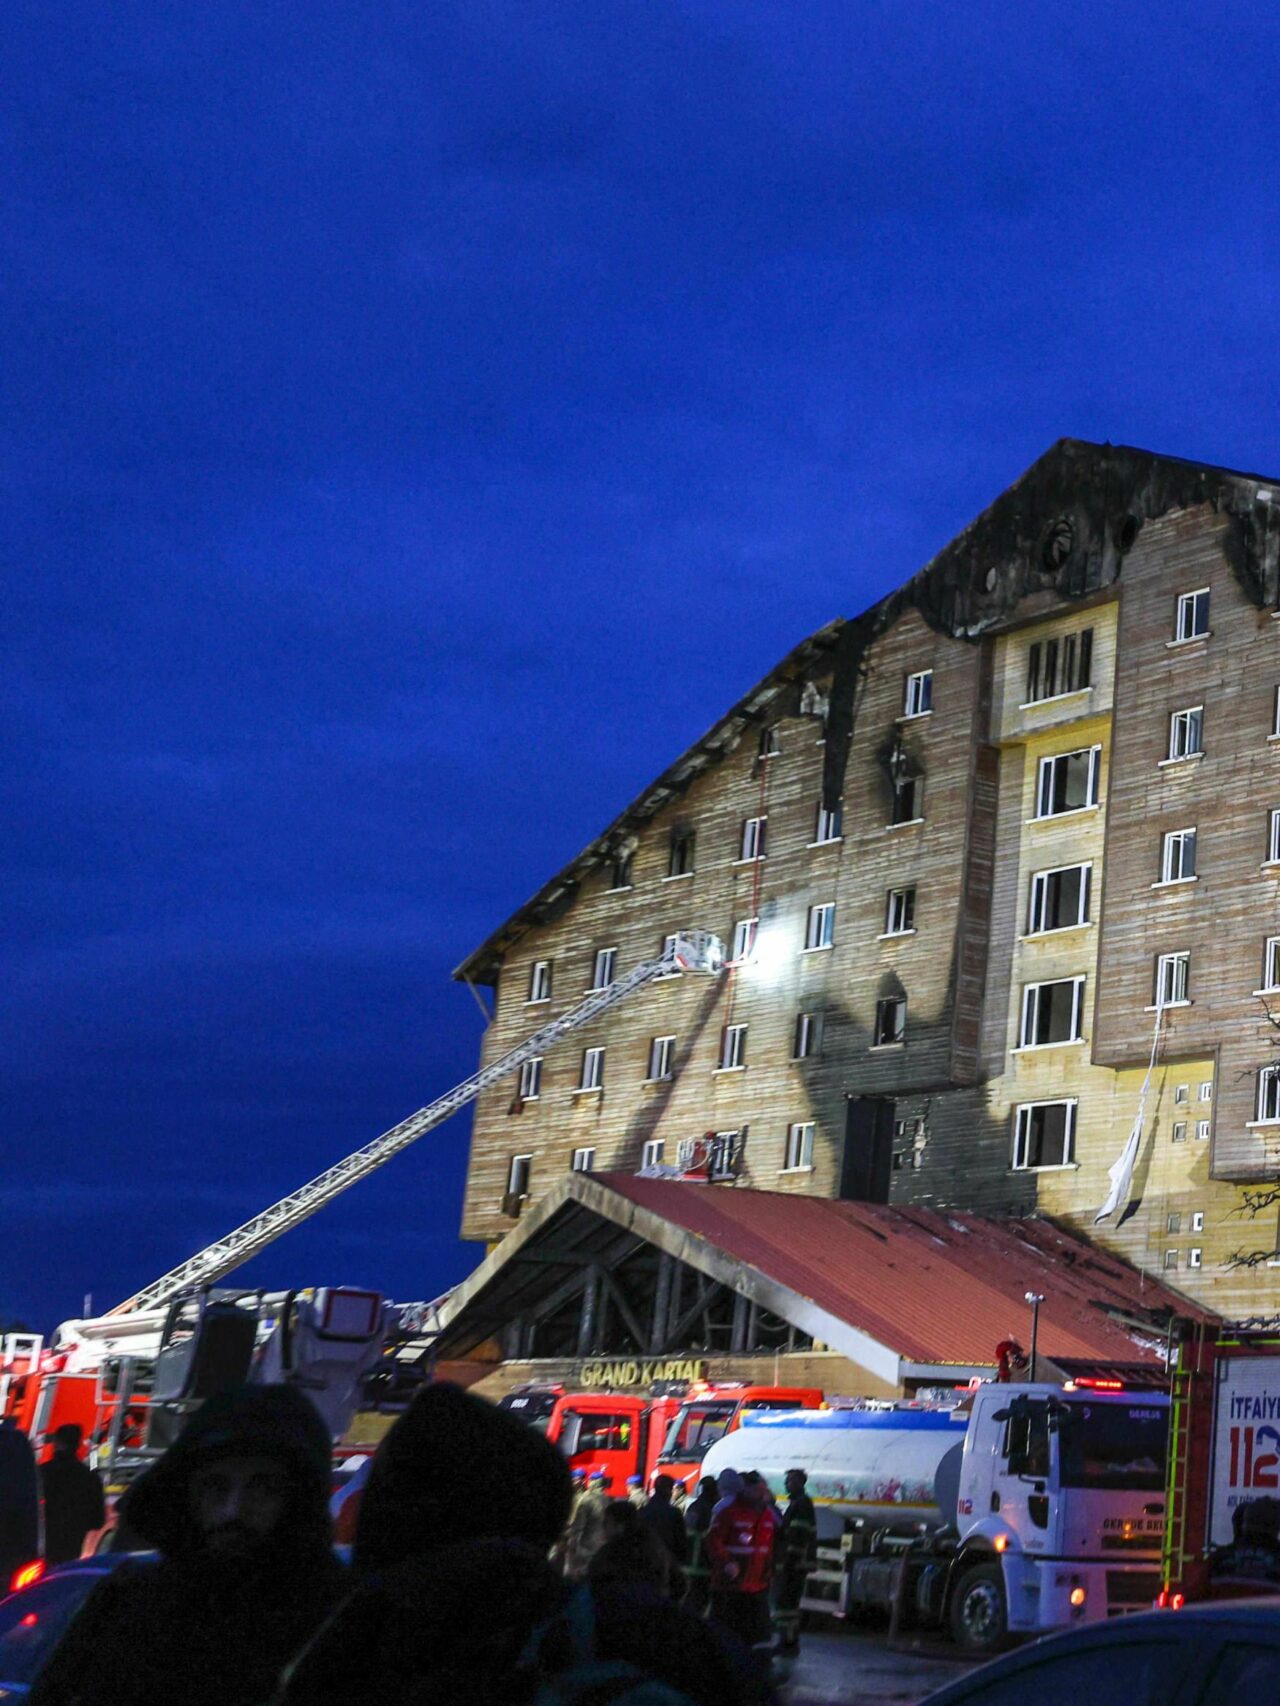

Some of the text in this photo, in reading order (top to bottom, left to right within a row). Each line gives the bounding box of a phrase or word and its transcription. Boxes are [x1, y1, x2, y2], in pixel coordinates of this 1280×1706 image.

[580, 1359, 702, 1387] GRAND KARTAL
[958, 1498, 973, 1515] 112
[1103, 1518, 1143, 1530] GERDE
